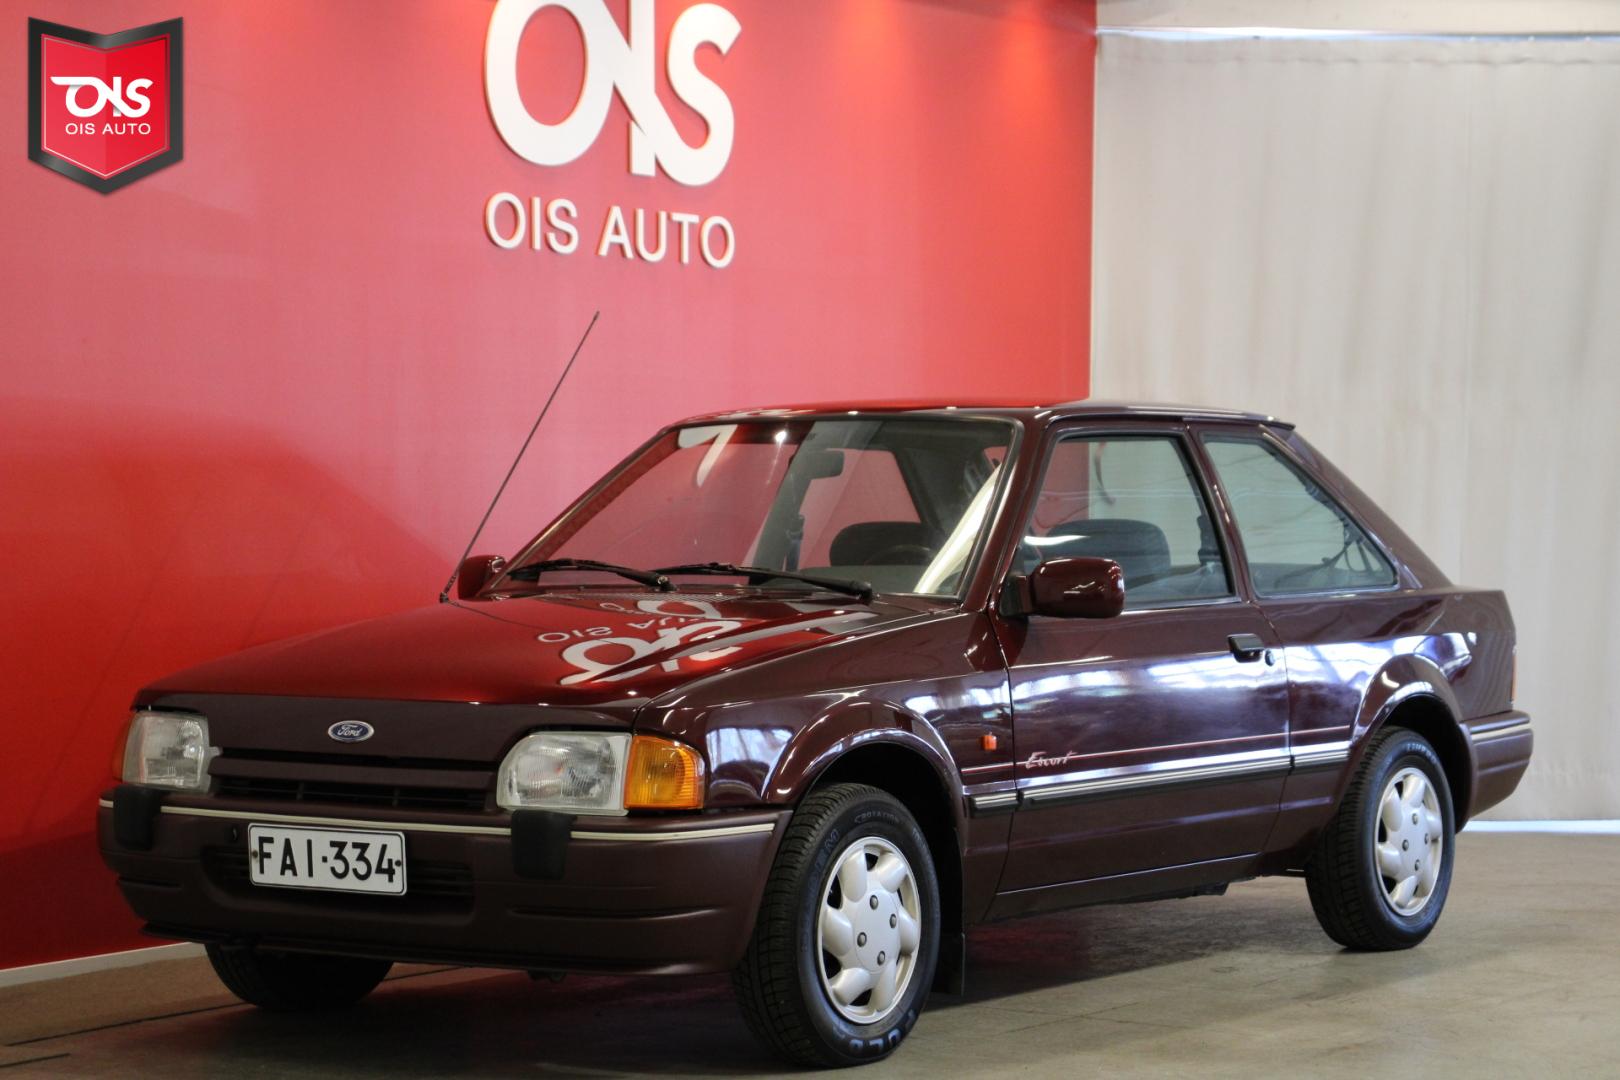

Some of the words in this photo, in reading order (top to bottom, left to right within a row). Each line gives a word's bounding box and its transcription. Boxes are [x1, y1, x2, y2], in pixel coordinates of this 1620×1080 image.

[485, 192, 579, 254] OIS
[598, 205, 735, 268] AUTO
[337, 724, 363, 737] Ford
[1025, 750, 1078, 769] Escort
